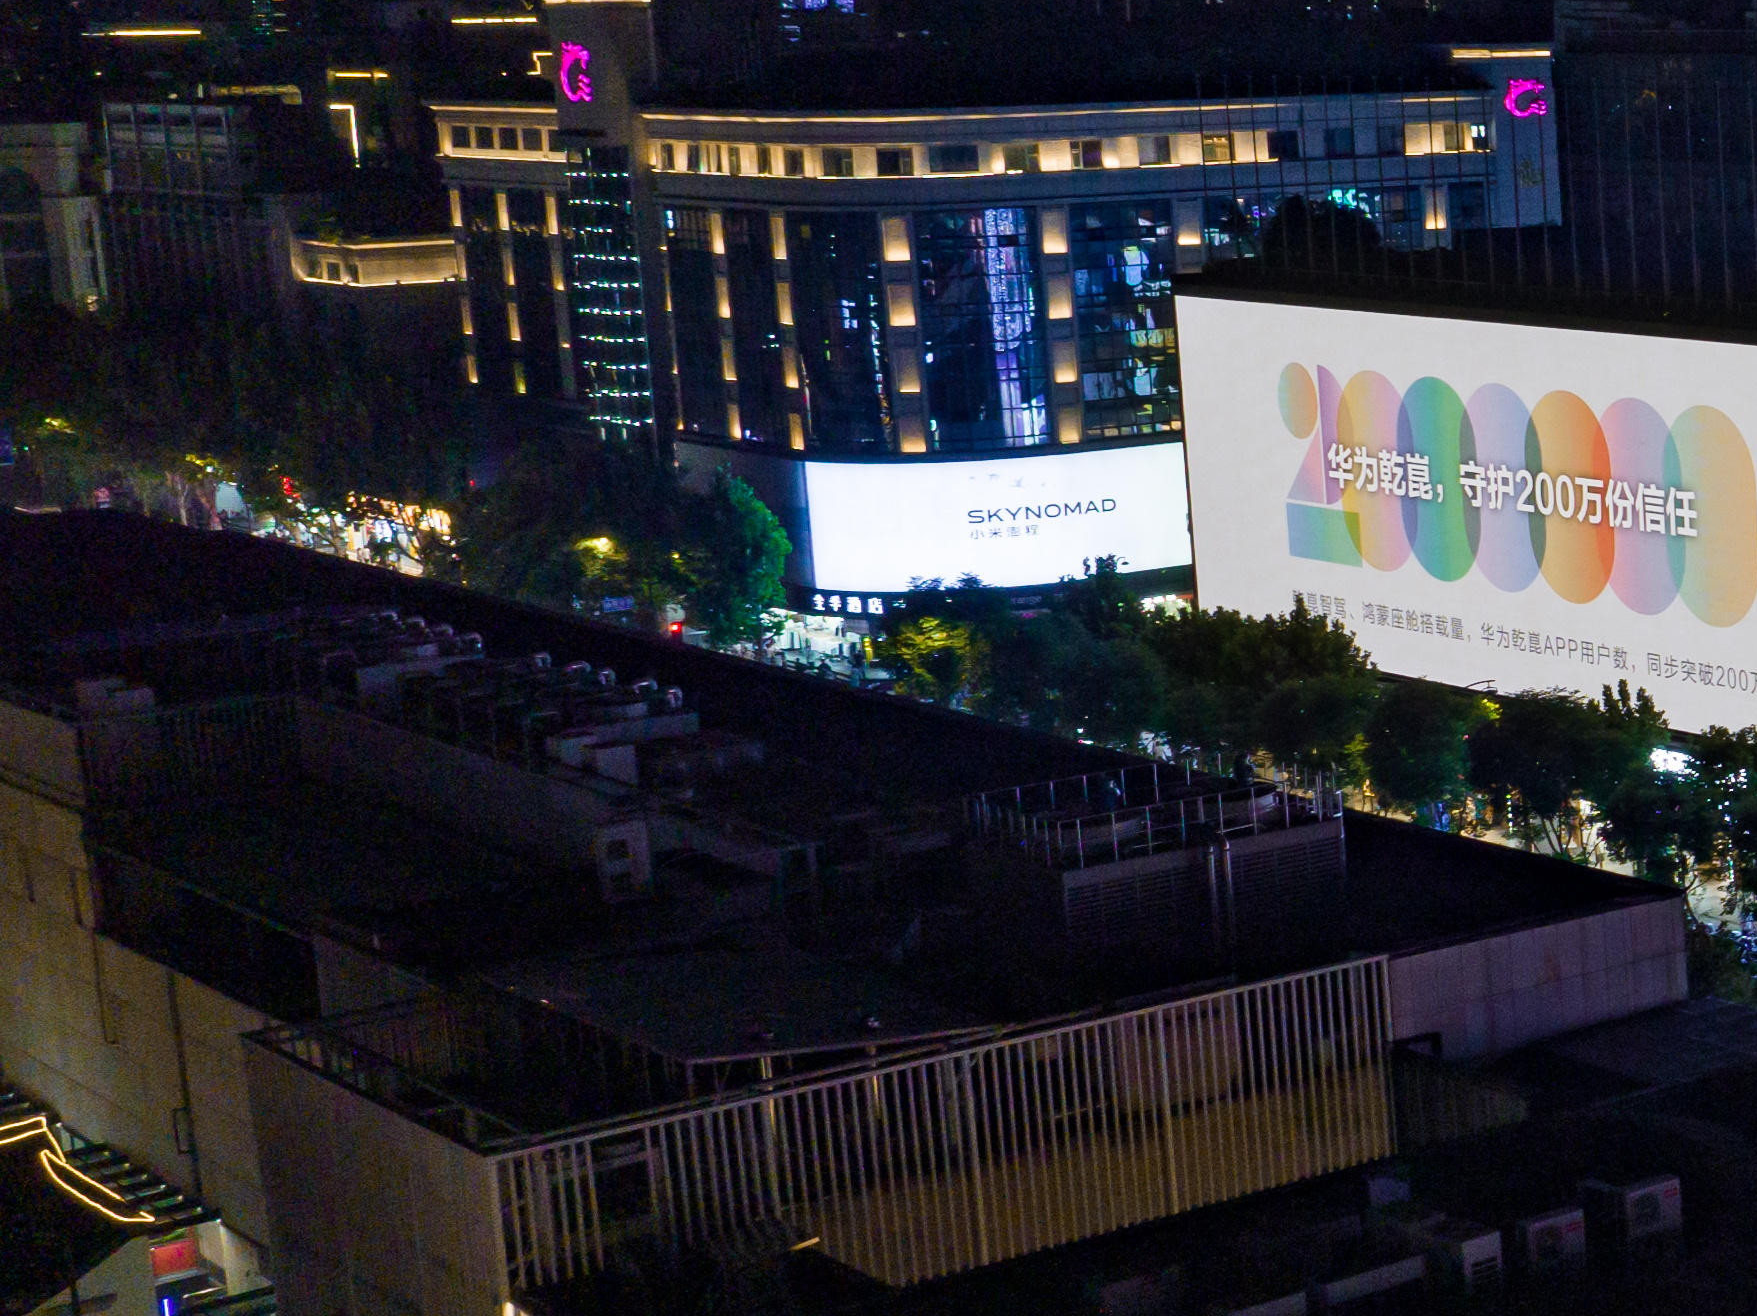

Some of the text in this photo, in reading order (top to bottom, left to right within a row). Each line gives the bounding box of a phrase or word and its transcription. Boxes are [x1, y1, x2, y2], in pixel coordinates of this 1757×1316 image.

[967, 499, 1116, 523] SKYNOMAD
[812, 594, 884, 614] 全季酒店
